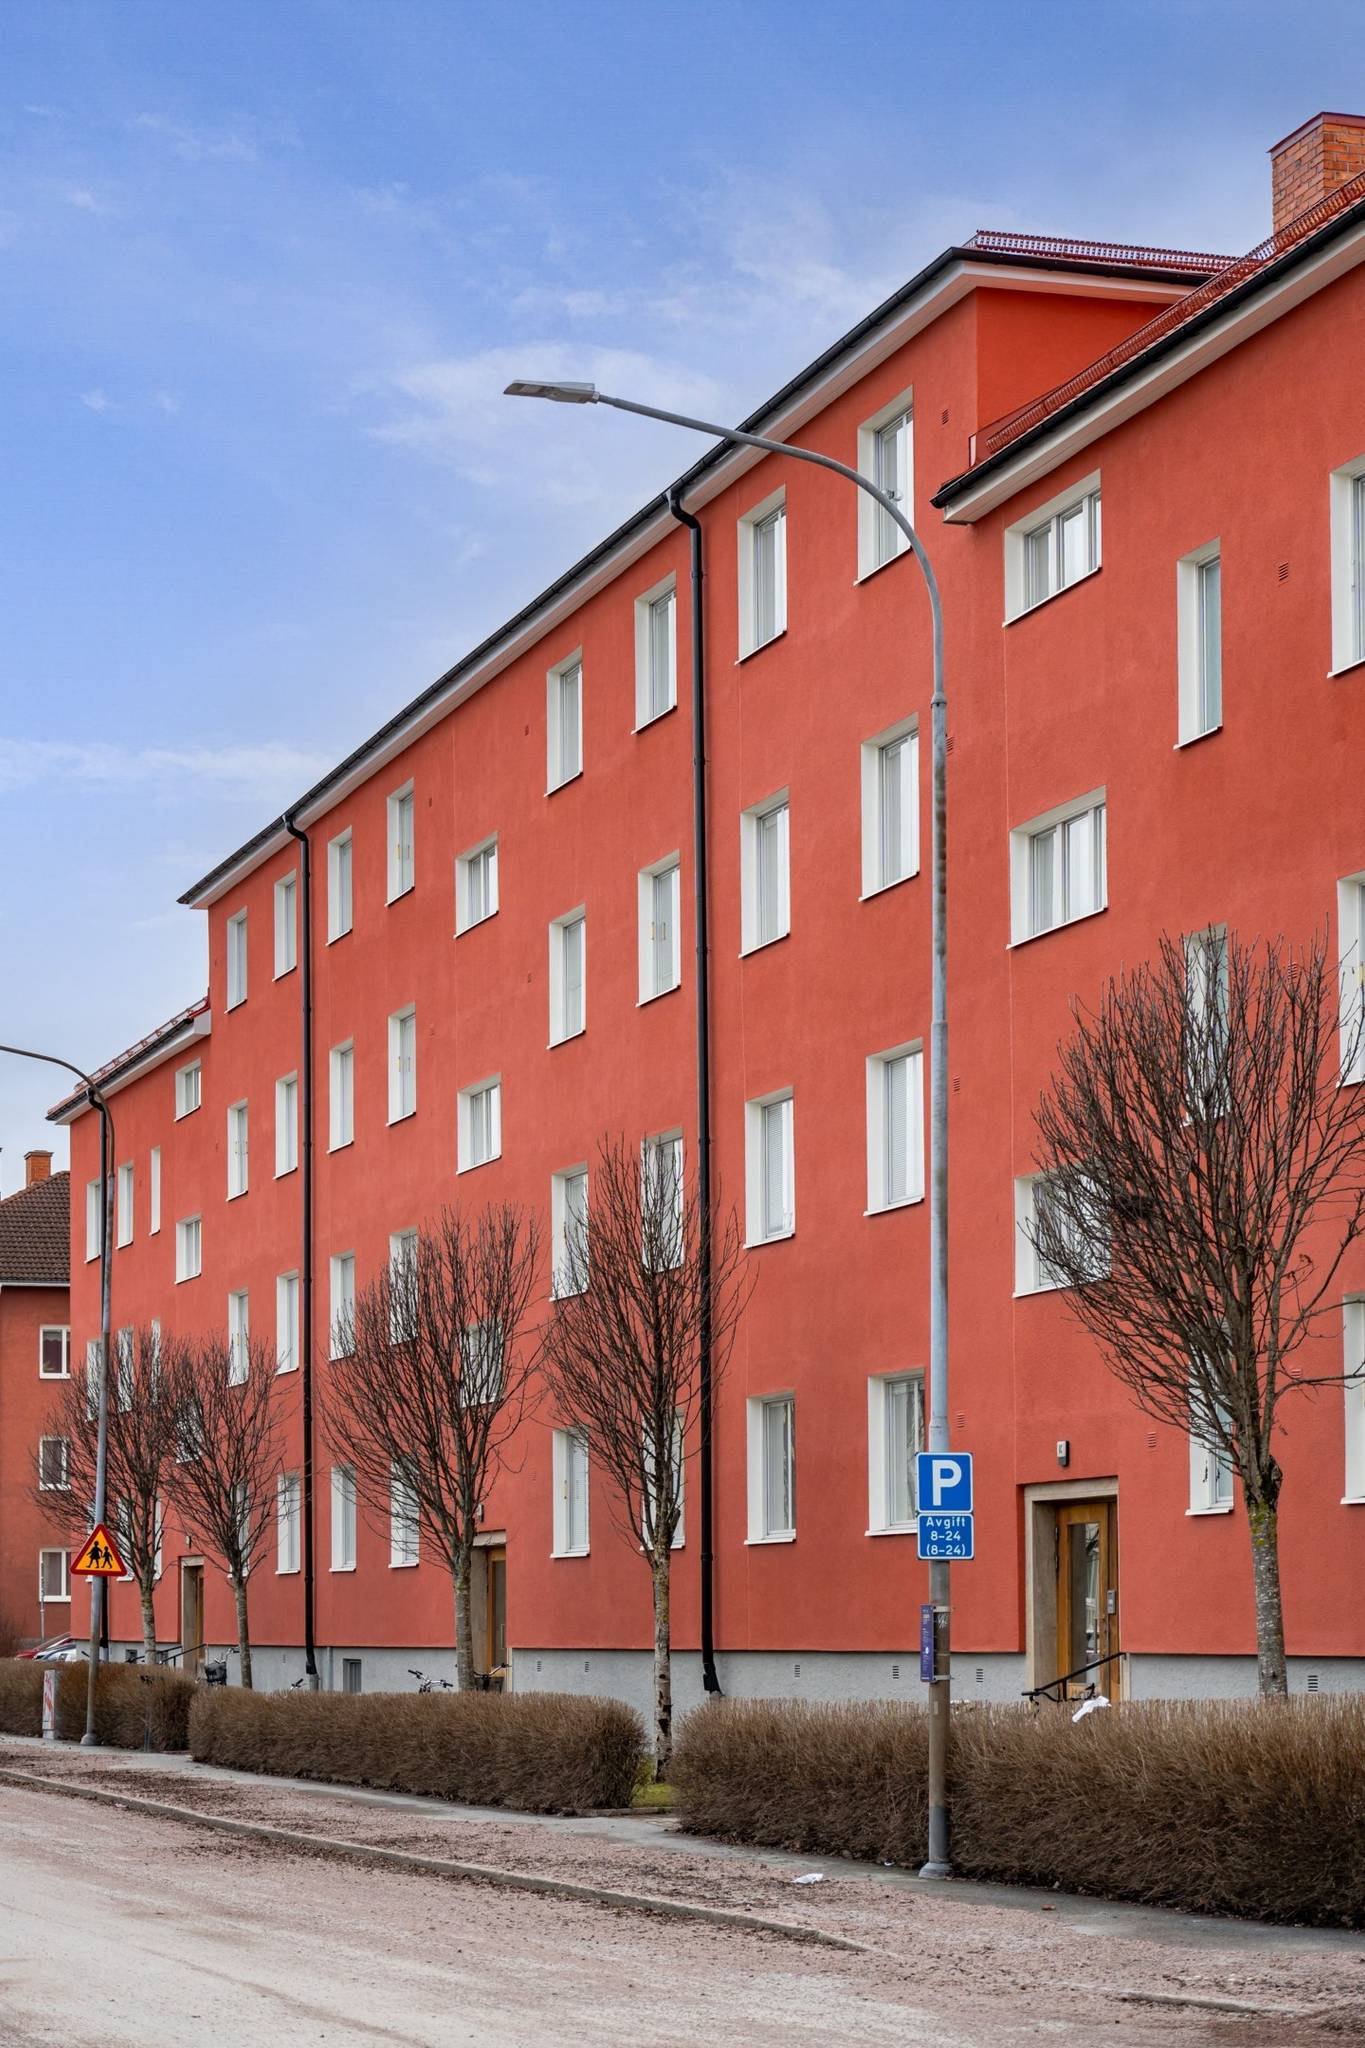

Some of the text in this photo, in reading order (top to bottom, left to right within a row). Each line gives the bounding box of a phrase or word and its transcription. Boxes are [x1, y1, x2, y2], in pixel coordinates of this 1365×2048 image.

[932, 1459, 962, 1506] P
[926, 1516, 966, 1530] Avgift
[930, 1530, 961, 1541] 8-24
[926, 1543, 966, 1556] (8-24)
